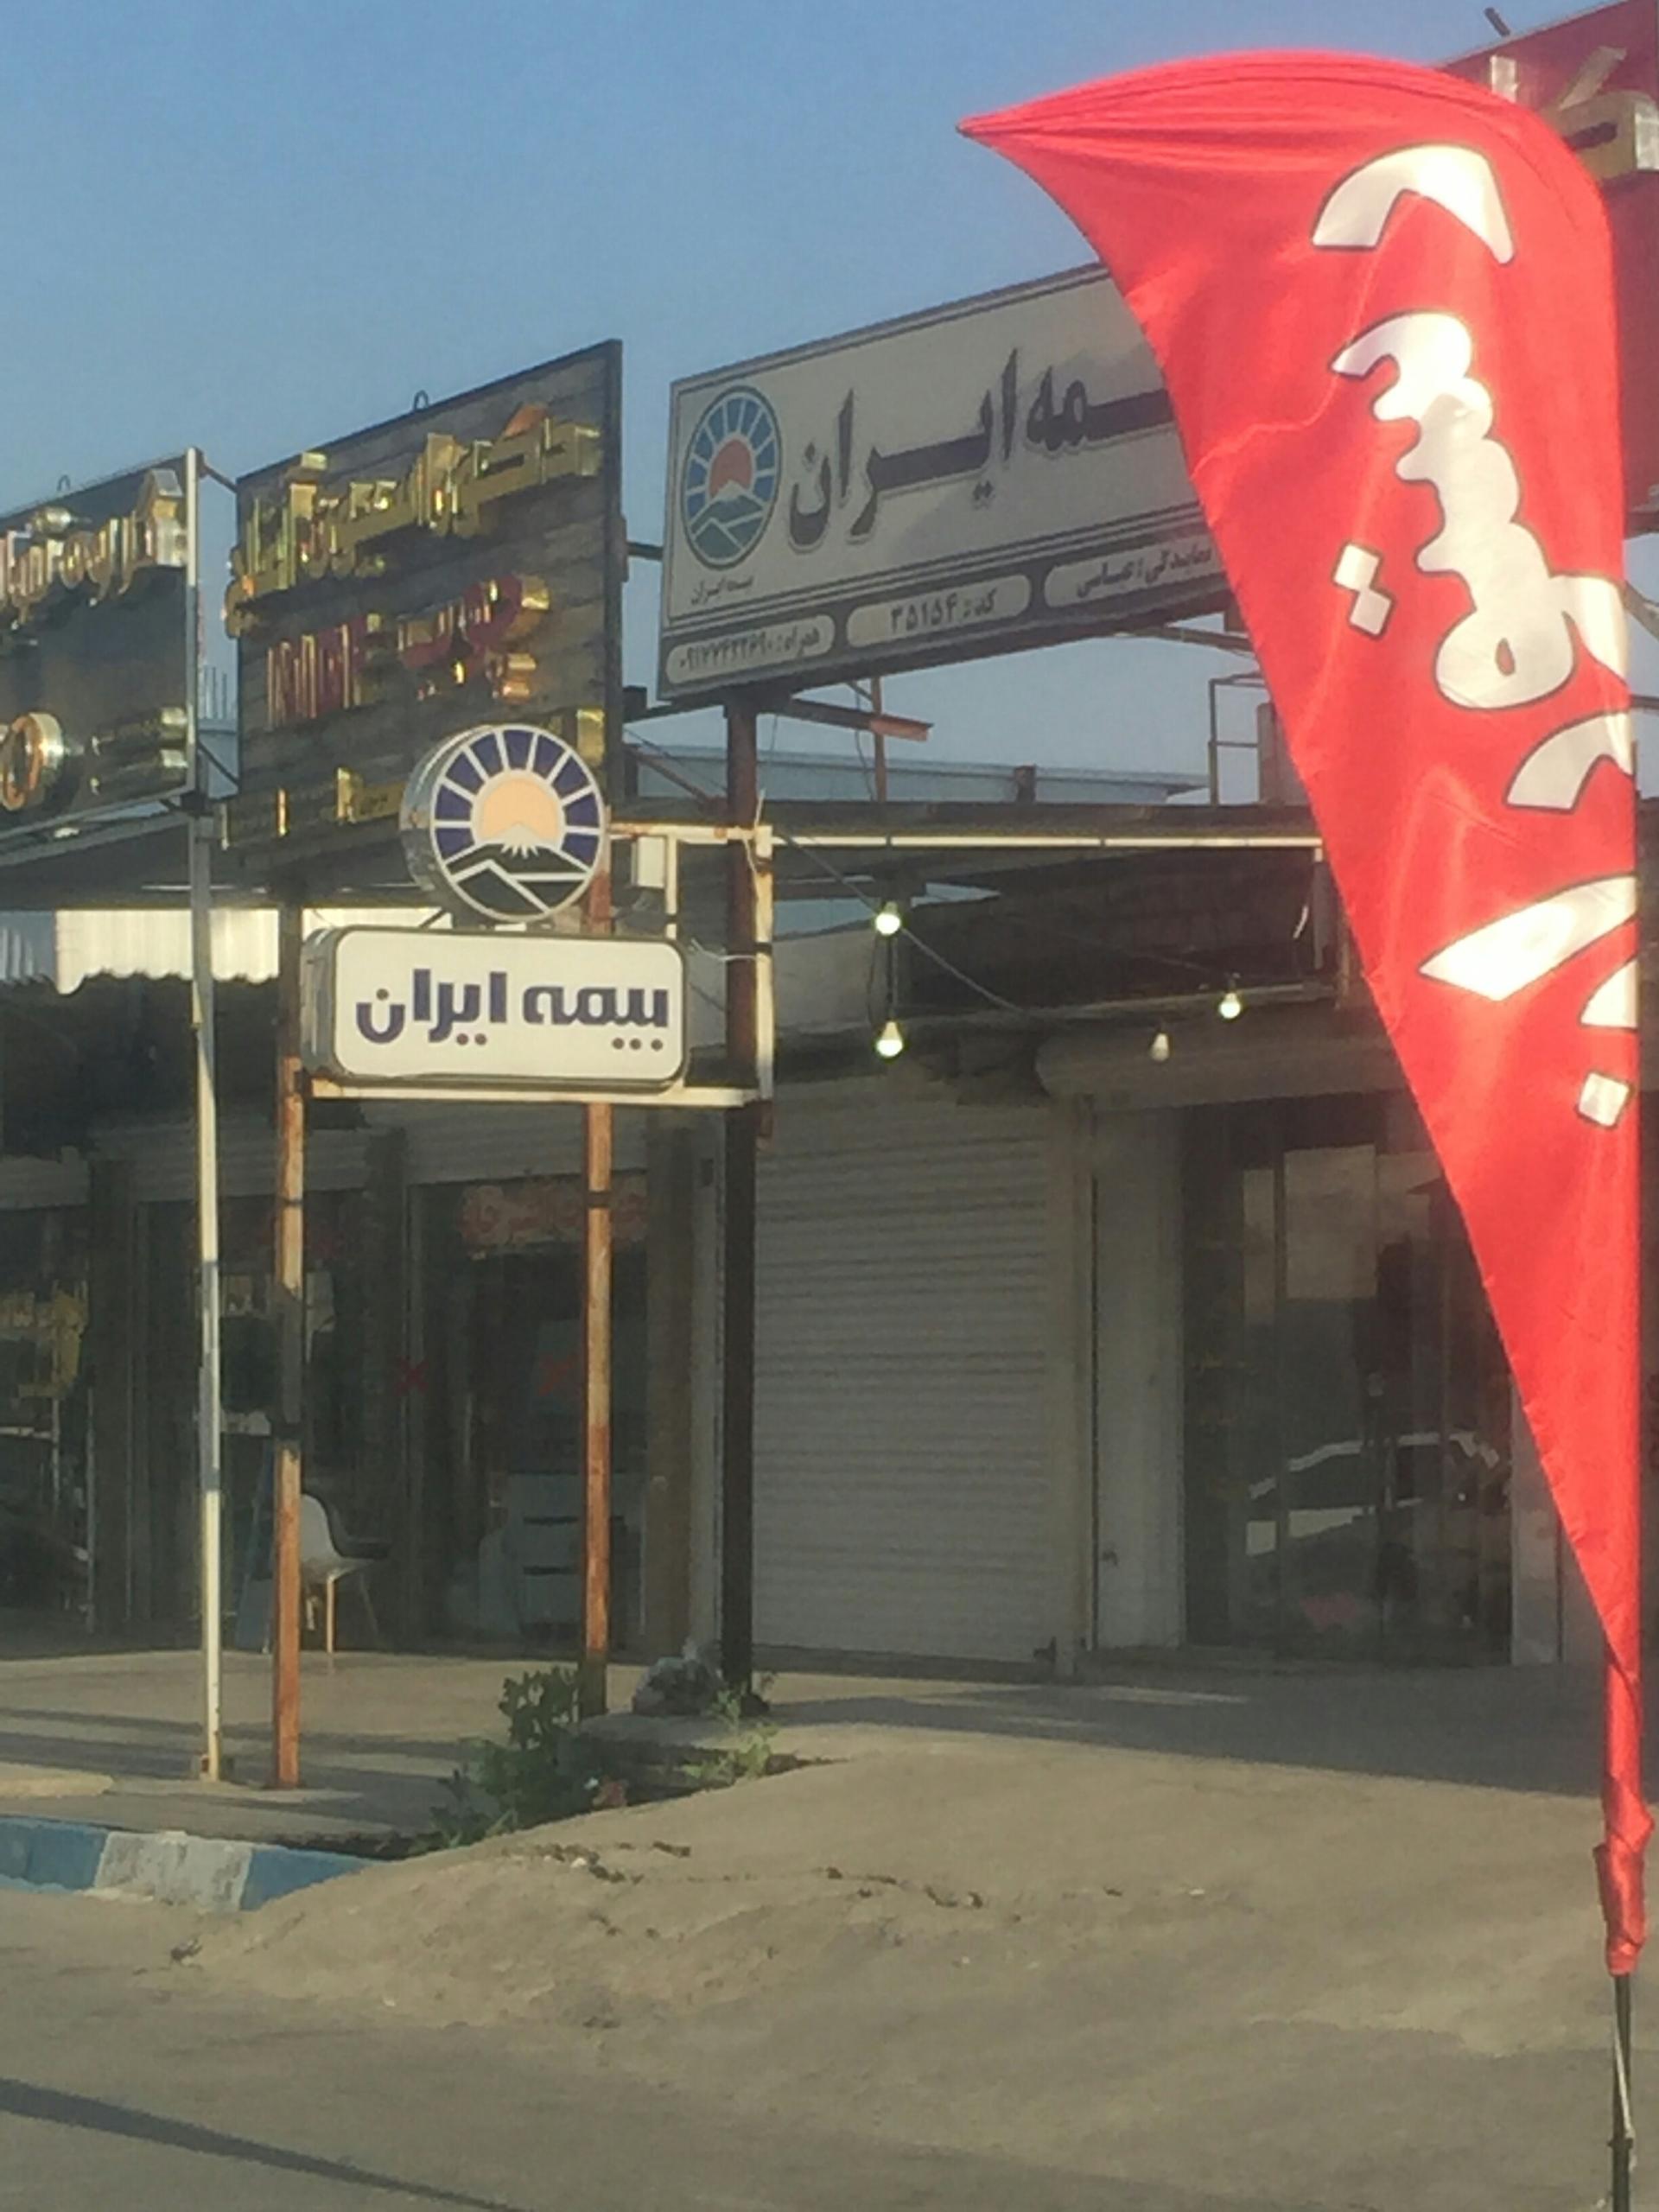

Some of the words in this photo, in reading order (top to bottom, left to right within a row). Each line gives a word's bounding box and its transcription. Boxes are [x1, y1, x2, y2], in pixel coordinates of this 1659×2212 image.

[790, 348, 1018, 546] ایران
[355, 968, 508, 1047] ایران
[523, 985, 670, 1052] بیمه
